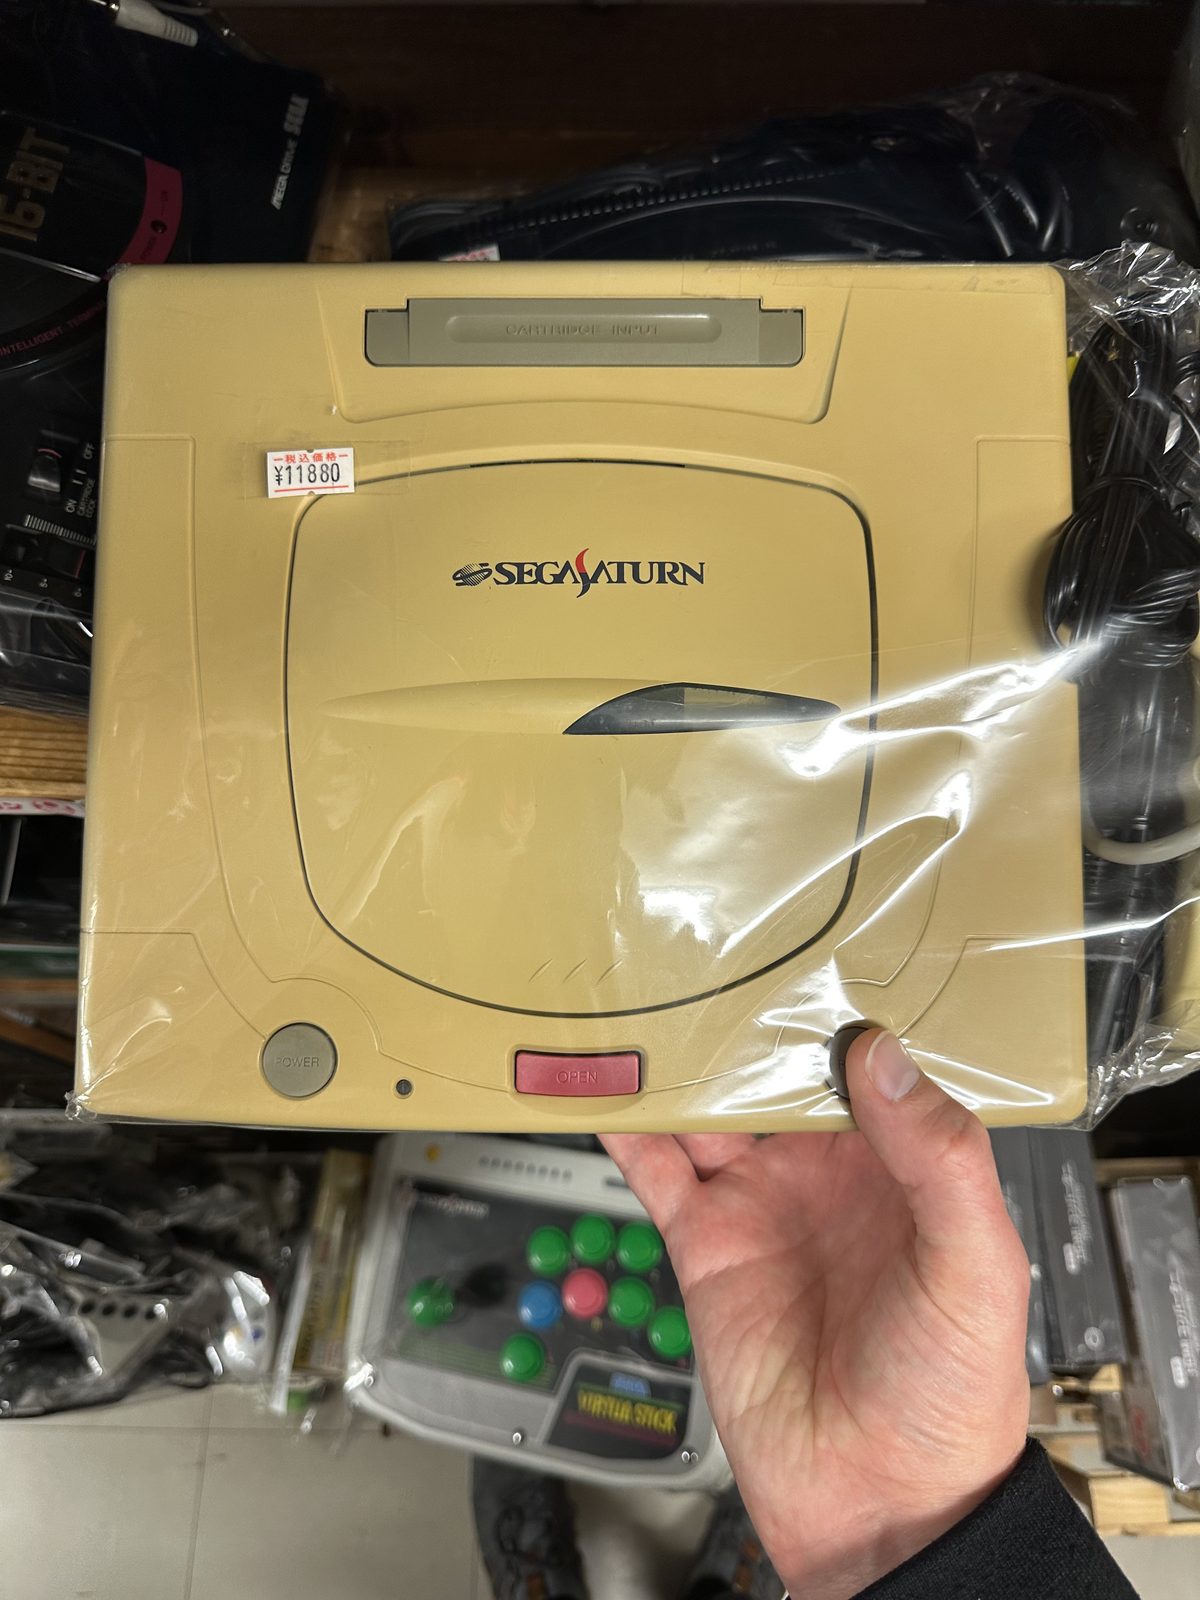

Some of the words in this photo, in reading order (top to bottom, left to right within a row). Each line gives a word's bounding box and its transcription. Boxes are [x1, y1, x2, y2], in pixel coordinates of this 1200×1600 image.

[612, 323, 658, 337] INPUT
[284, 451, 337, 464] 税込価格
[274, 462, 341, 487] ¥11880
[65, 499, 78, 514] ON
[492, 559, 580, 586] SEGA
[574, 547, 706, 599] SATURN
[276, 1056, 320, 1068] POWER
[556, 1070, 598, 1084] OPEN
